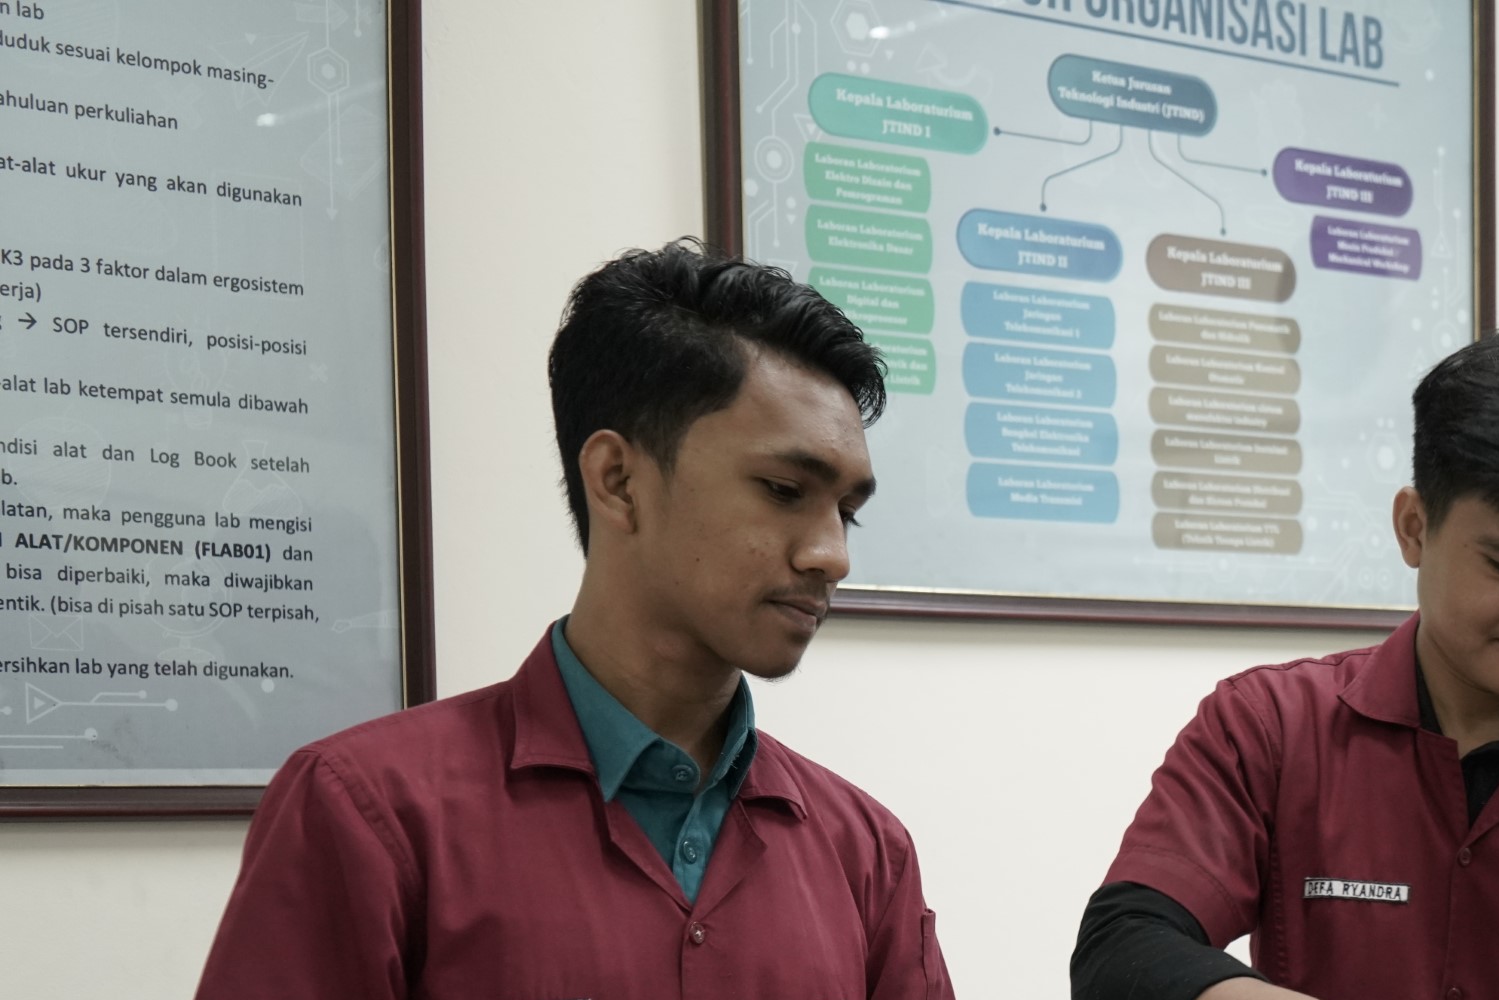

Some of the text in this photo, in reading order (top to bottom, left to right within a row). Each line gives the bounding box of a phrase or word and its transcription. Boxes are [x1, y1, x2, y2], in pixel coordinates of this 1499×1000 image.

[16, 0, 44, 20] lab
[1319, 7, 1384, 70] LAB
[0, 30, 274, 89] uduk sesuai kelompok masing-
[1092, 70, 1172, 96] Ketua Jurusan
[836, 88, 883, 108] Kepala
[1058, 86, 1205, 125] Teknologi Industri (JTIND)
[75, 104, 178, 130] perkuliahan
[882, 119, 922, 138] JTIND
[1295, 158, 1332, 176] Kepala
[66, 162, 107, 182] ukur
[115, 172, 157, 192] yang
[166, 175, 207, 195] akan
[217, 181, 302, 207] digunakan
[894, 179, 913, 191] dan
[978, 222, 1021, 240] Kepala
[1017, 250, 1055, 267] JTIND
[1167, 246, 1207, 264] Kepala
[1, 249, 303, 296] K3 pada 3 faktor dalam ergosistem
[53, 317, 306, 355] SOP tersendiri, posisi-posisi
[44, 377, 71, 395] lab
[79, 380, 163, 404] ketempat
[170, 391, 230, 408] semula
[238, 394, 308, 414] dibawah
[53, 441, 87, 458] alat
[102, 444, 134, 461] dan
[151, 448, 180, 468] Log
[195, 451, 237, 468] Book
[251, 456, 309, 473] setelah
[63, 505, 110, 521] maka
[122, 511, 205, 528] pengguna
[215, 512, 240, 528] lab
[249, 517, 312, 535] mengisi
[15, 533, 183, 555] ALAT/KOMPONEN
[195, 540, 271, 563] (FLAB01)
[283, 545, 312, 561] dan
[6, 563, 313, 593] bisa diperbaiki, maka diwajibkan
[51, 595, 92, 615] (bisa
[98, 598, 113, 613] di
[119, 599, 164, 618] pisah
[168, 603, 204, 617] satu
[209, 602, 242, 618] SOP
[247, 605, 319, 623] terpisah,
[76, 658, 102, 674] lab
[107, 663, 149, 679] yang
[154, 660, 197, 676] telah
[203, 661, 293, 680] digunakan.
[1308, 881, 1400, 900] DEFA RYANDRA
